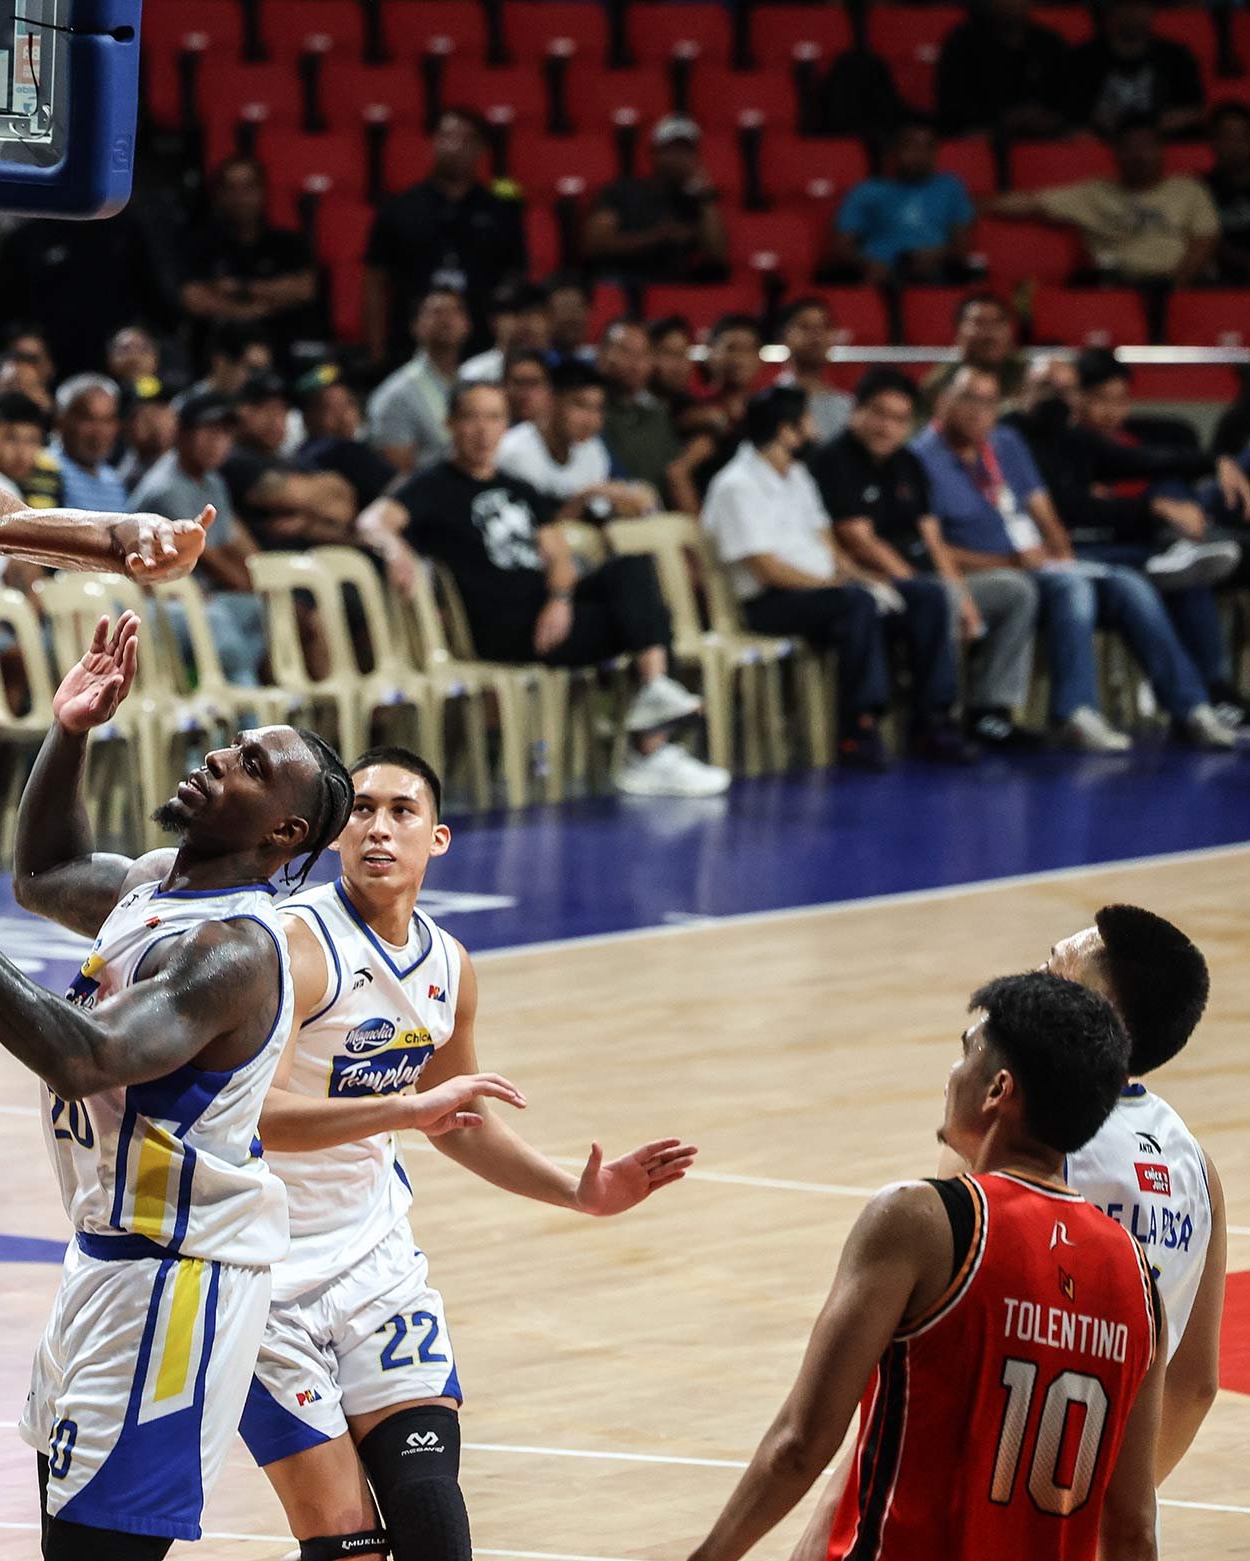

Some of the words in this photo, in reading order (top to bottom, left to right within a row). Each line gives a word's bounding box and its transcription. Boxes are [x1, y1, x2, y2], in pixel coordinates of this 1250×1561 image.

[345, 1022, 393, 1052] Magnolia
[1130, 1204, 1157, 1246] LA
[375, 1310, 449, 1373] 22
[1003, 1297, 1129, 1364] TOLENTINO
[990, 1357, 1109, 1517] 10
